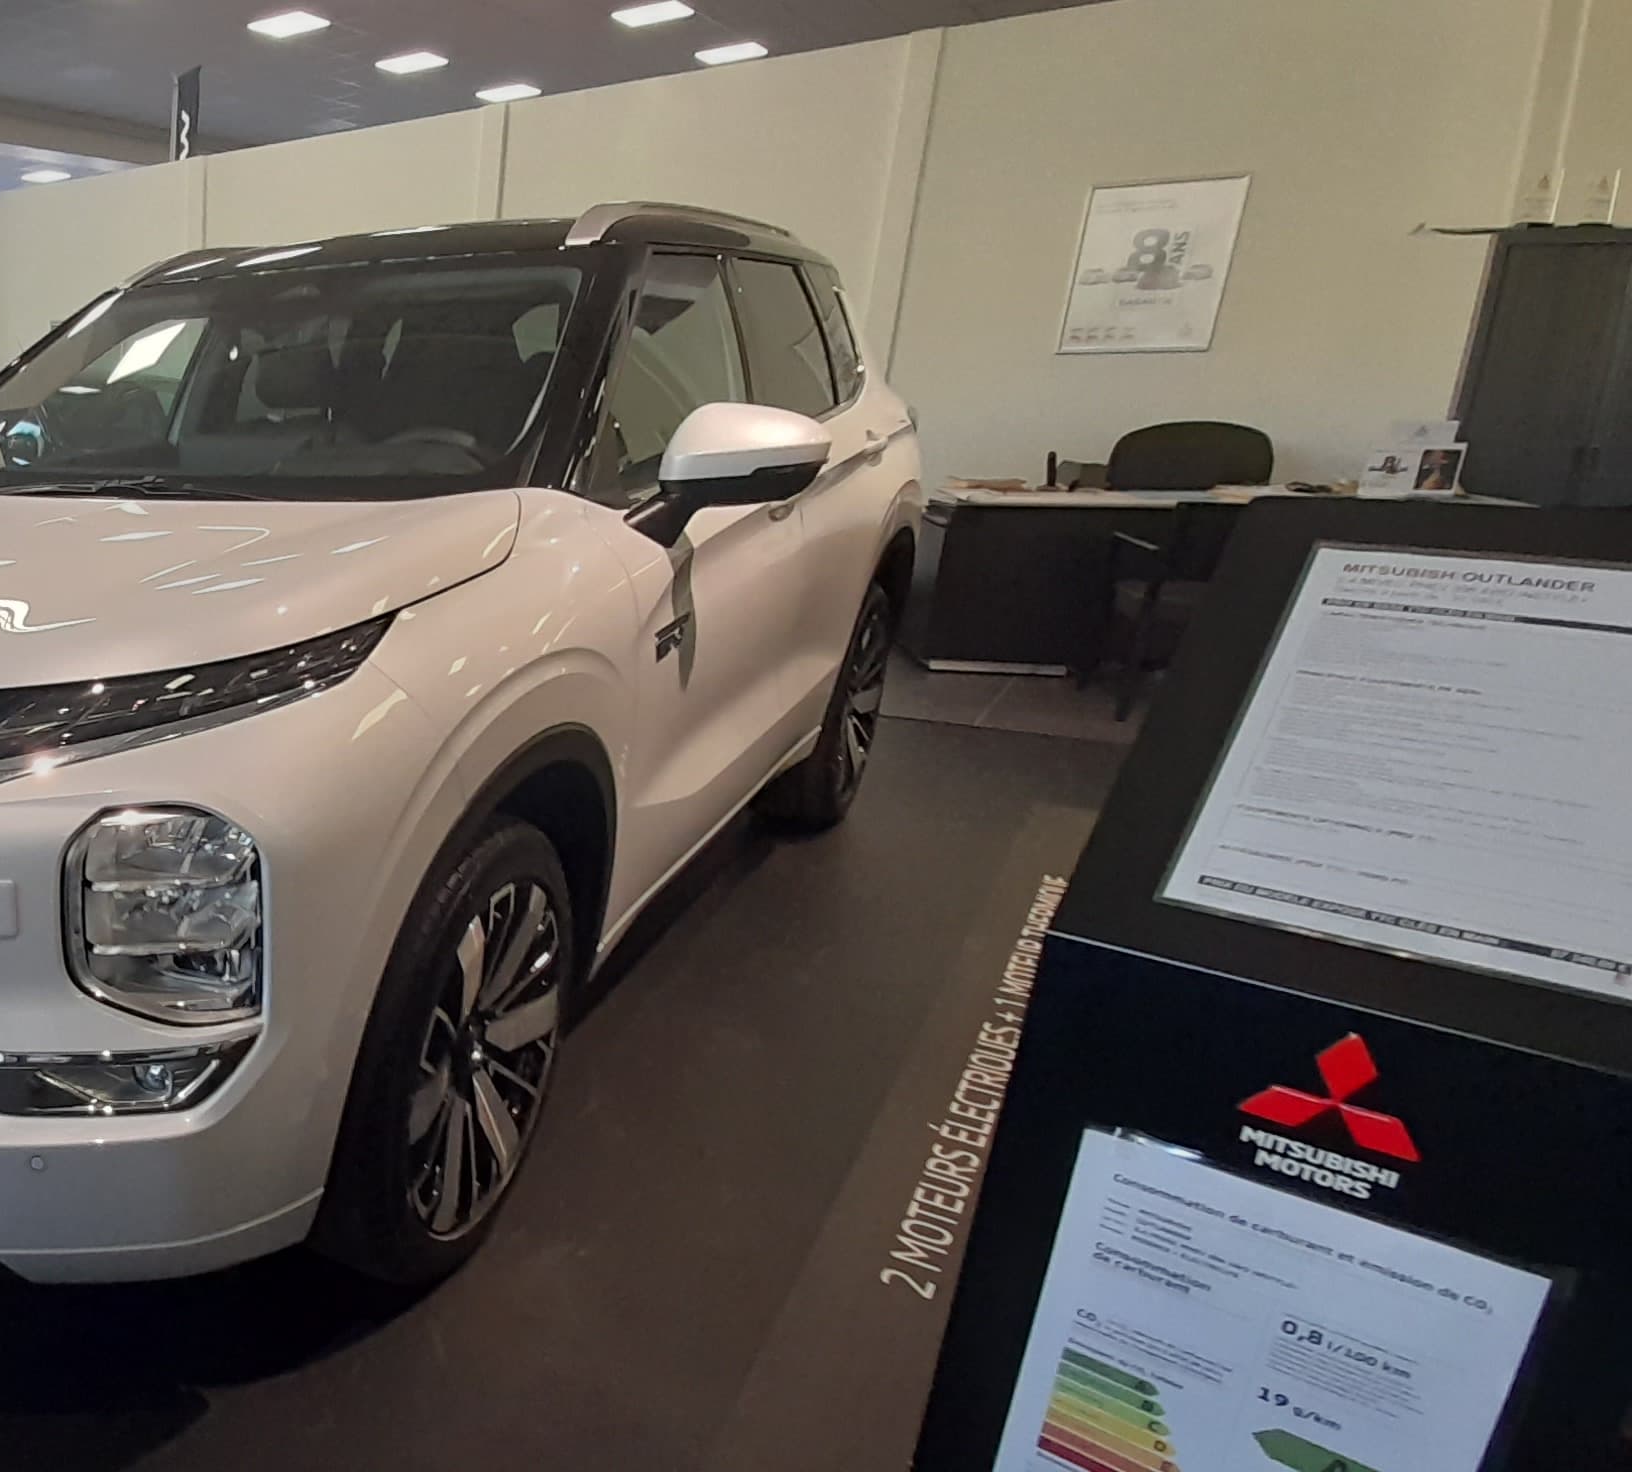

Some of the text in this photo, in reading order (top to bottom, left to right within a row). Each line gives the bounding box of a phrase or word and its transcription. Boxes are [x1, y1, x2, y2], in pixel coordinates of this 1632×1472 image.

[1127, 228, 1170, 271] 8
[1169, 231, 1191, 265] ANS
[1462, 571, 1596, 593] OUTLANDER
[927, 1021, 1023, 1149] ÉLECTRIQUES
[1239, 1125, 1400, 1190] MITSUBISHI
[1254, 1148, 1373, 1200] MOTORS
[890, 1143, 982, 1273] MOTEURS
[1113, 1173, 1225, 1218] Consommation
[1229, 1214, 1248, 1227] de
[1251, 1222, 1334, 1256] carburant
[1337, 1251, 1355, 1265] et
[1437, 1287, 1460, 1301] de
[880, 1267, 937, 1300] 2
[1095, 1241, 1212, 1292] Consommation
[1280, 1319, 1324, 1346] 0,8
[1382, 1361, 1412, 1380] km
[1257, 1386, 1290, 1408] 19
